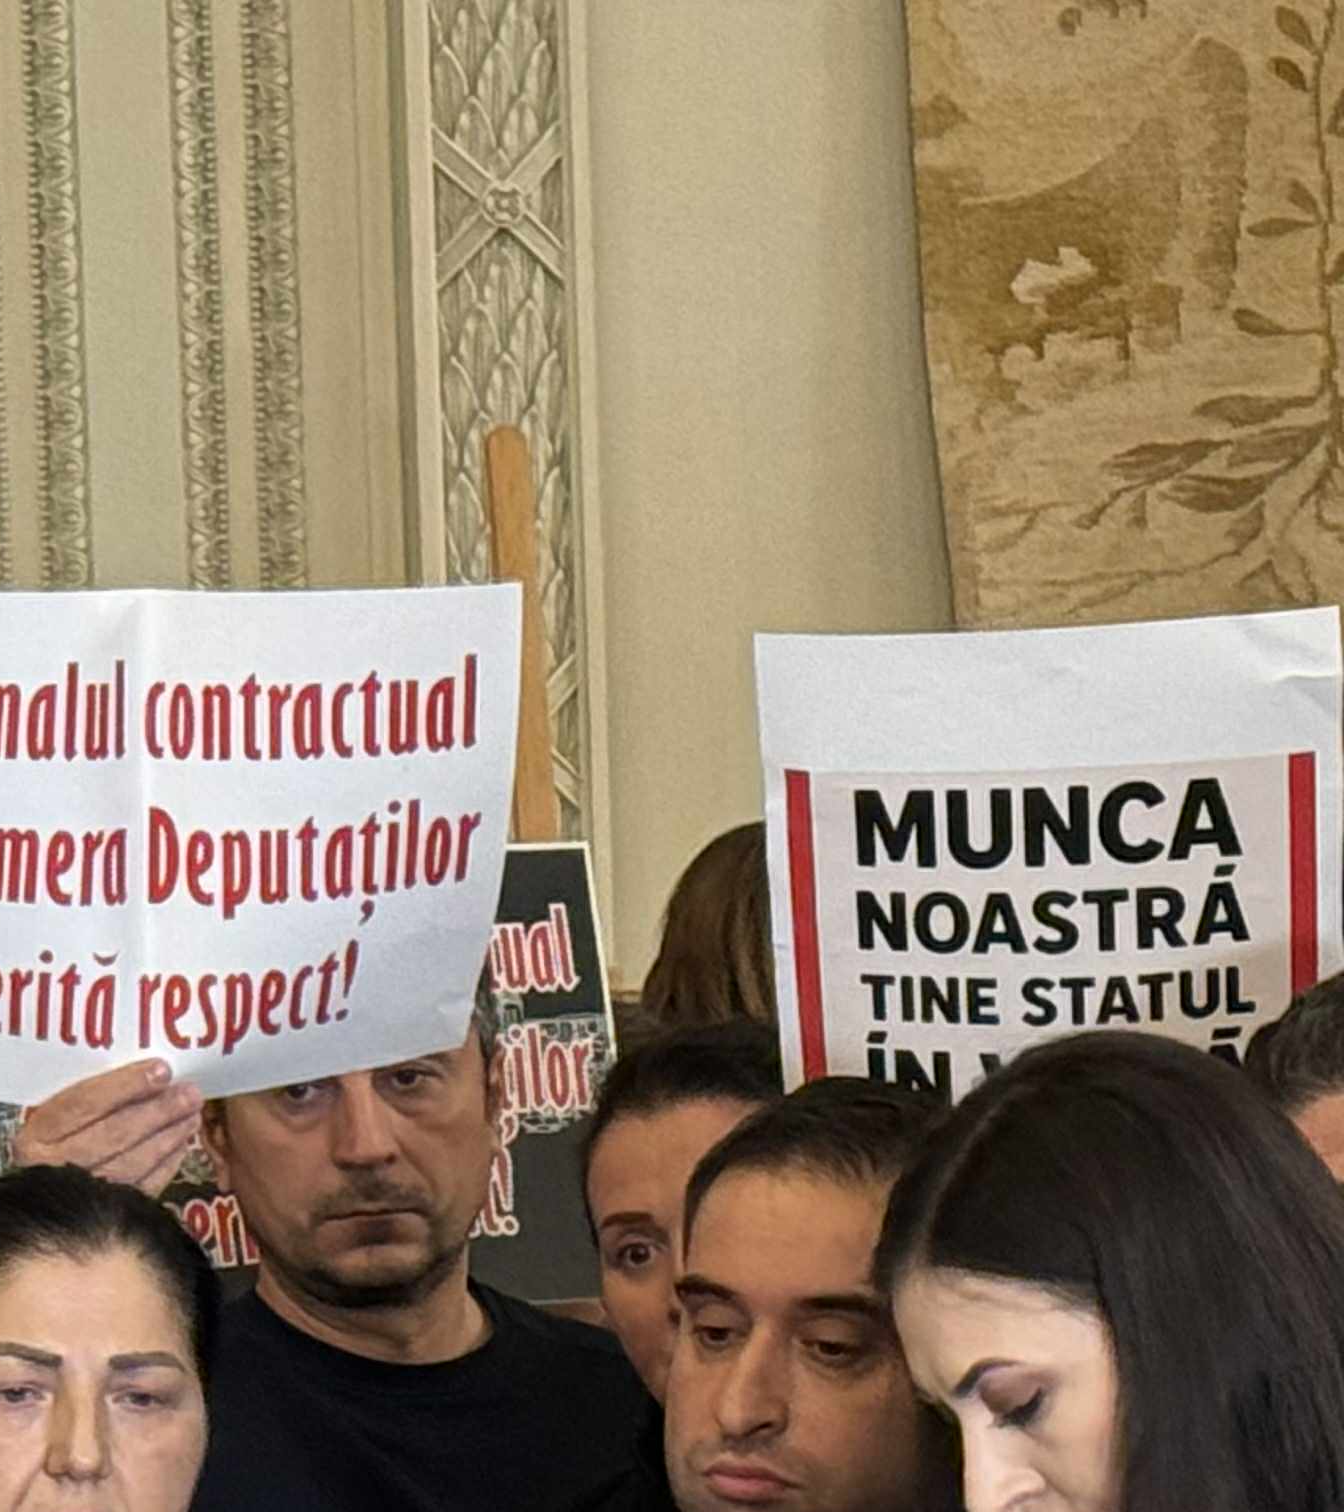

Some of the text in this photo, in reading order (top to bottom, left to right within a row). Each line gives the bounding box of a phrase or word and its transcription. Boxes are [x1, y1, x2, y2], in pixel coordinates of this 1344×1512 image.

[144, 653, 478, 761] contractual
[148, 799, 482, 924] Deputaților
[854, 777, 1243, 869] MUNCA
[138, 939, 359, 1055] respect!
[1021, 966, 1257, 1027] STATUL
